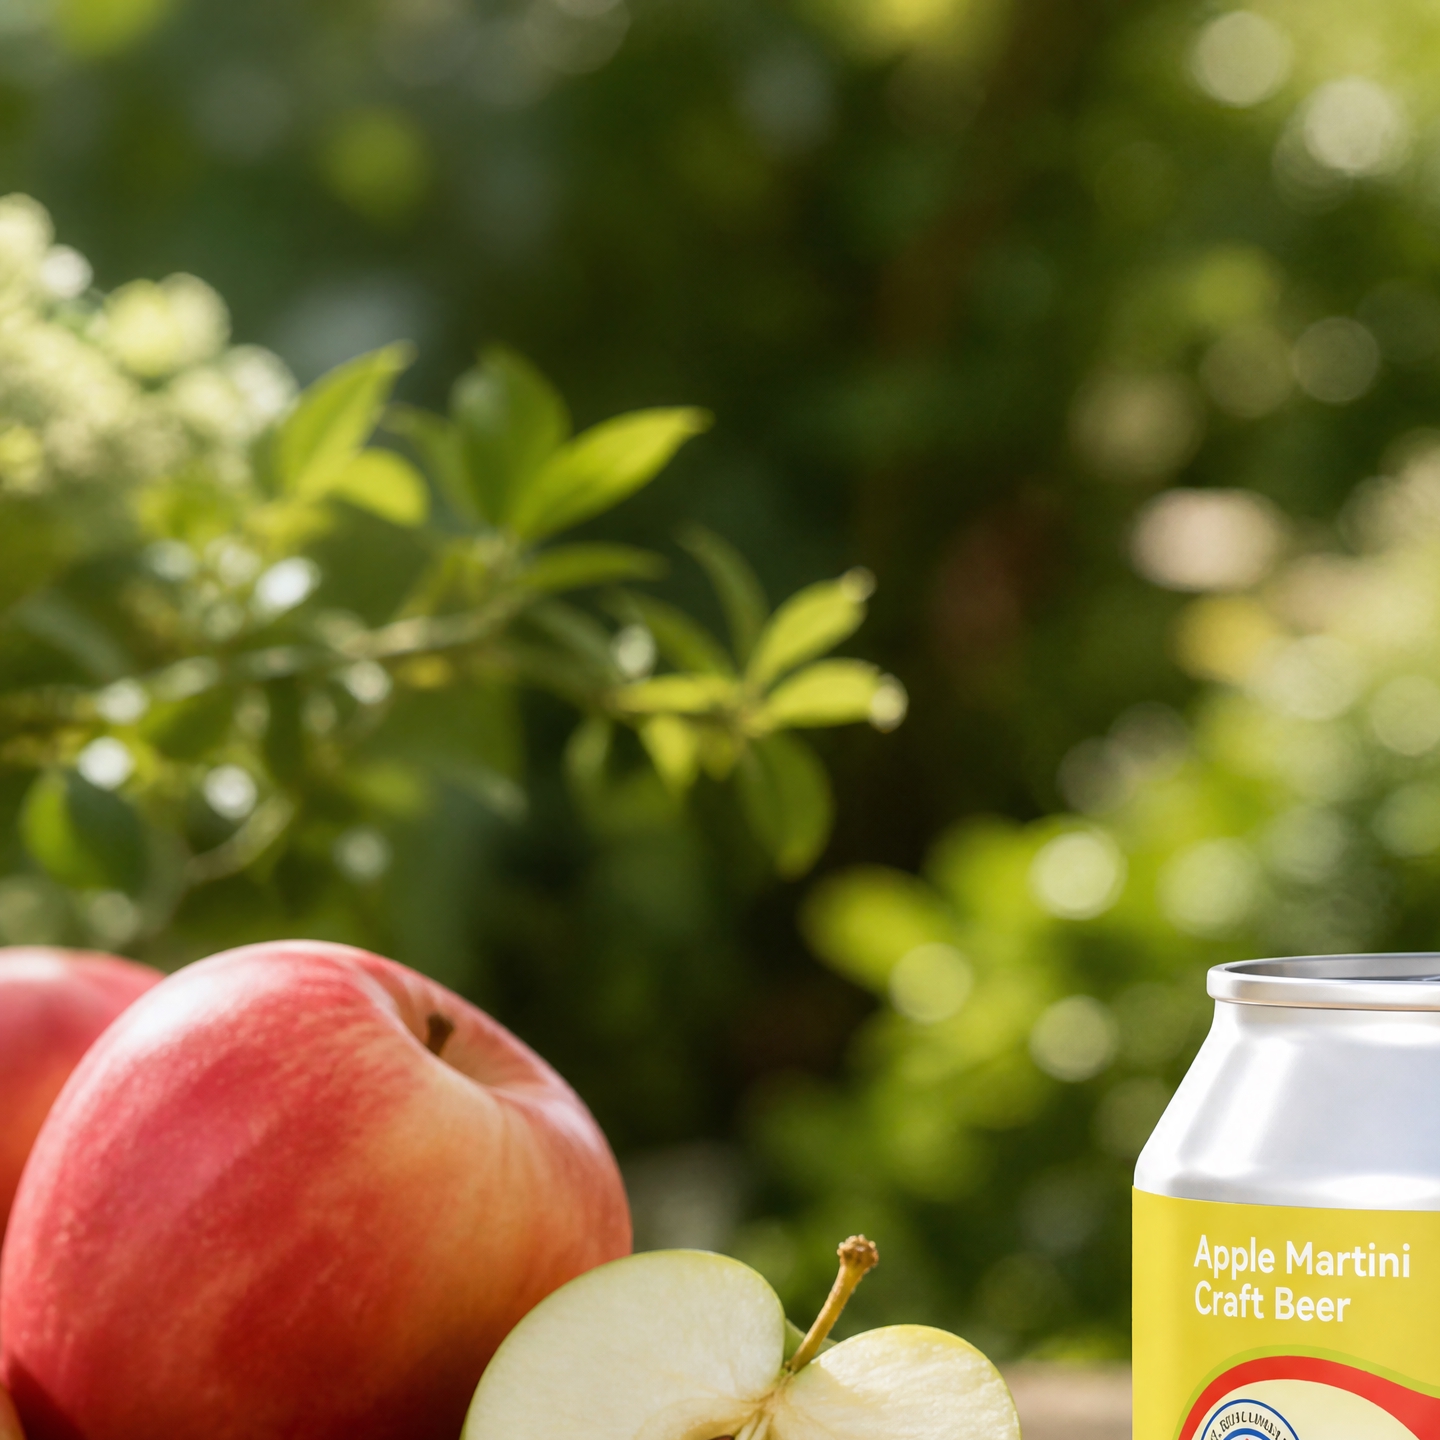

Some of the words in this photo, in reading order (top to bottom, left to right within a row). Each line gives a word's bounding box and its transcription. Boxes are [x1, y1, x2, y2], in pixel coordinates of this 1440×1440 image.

[1193, 1234, 1275, 1280] Apple
[1286, 1241, 1410, 1278] Martini
[1195, 1280, 1265, 1319] Craft
[1275, 1286, 1351, 1322] Beer
